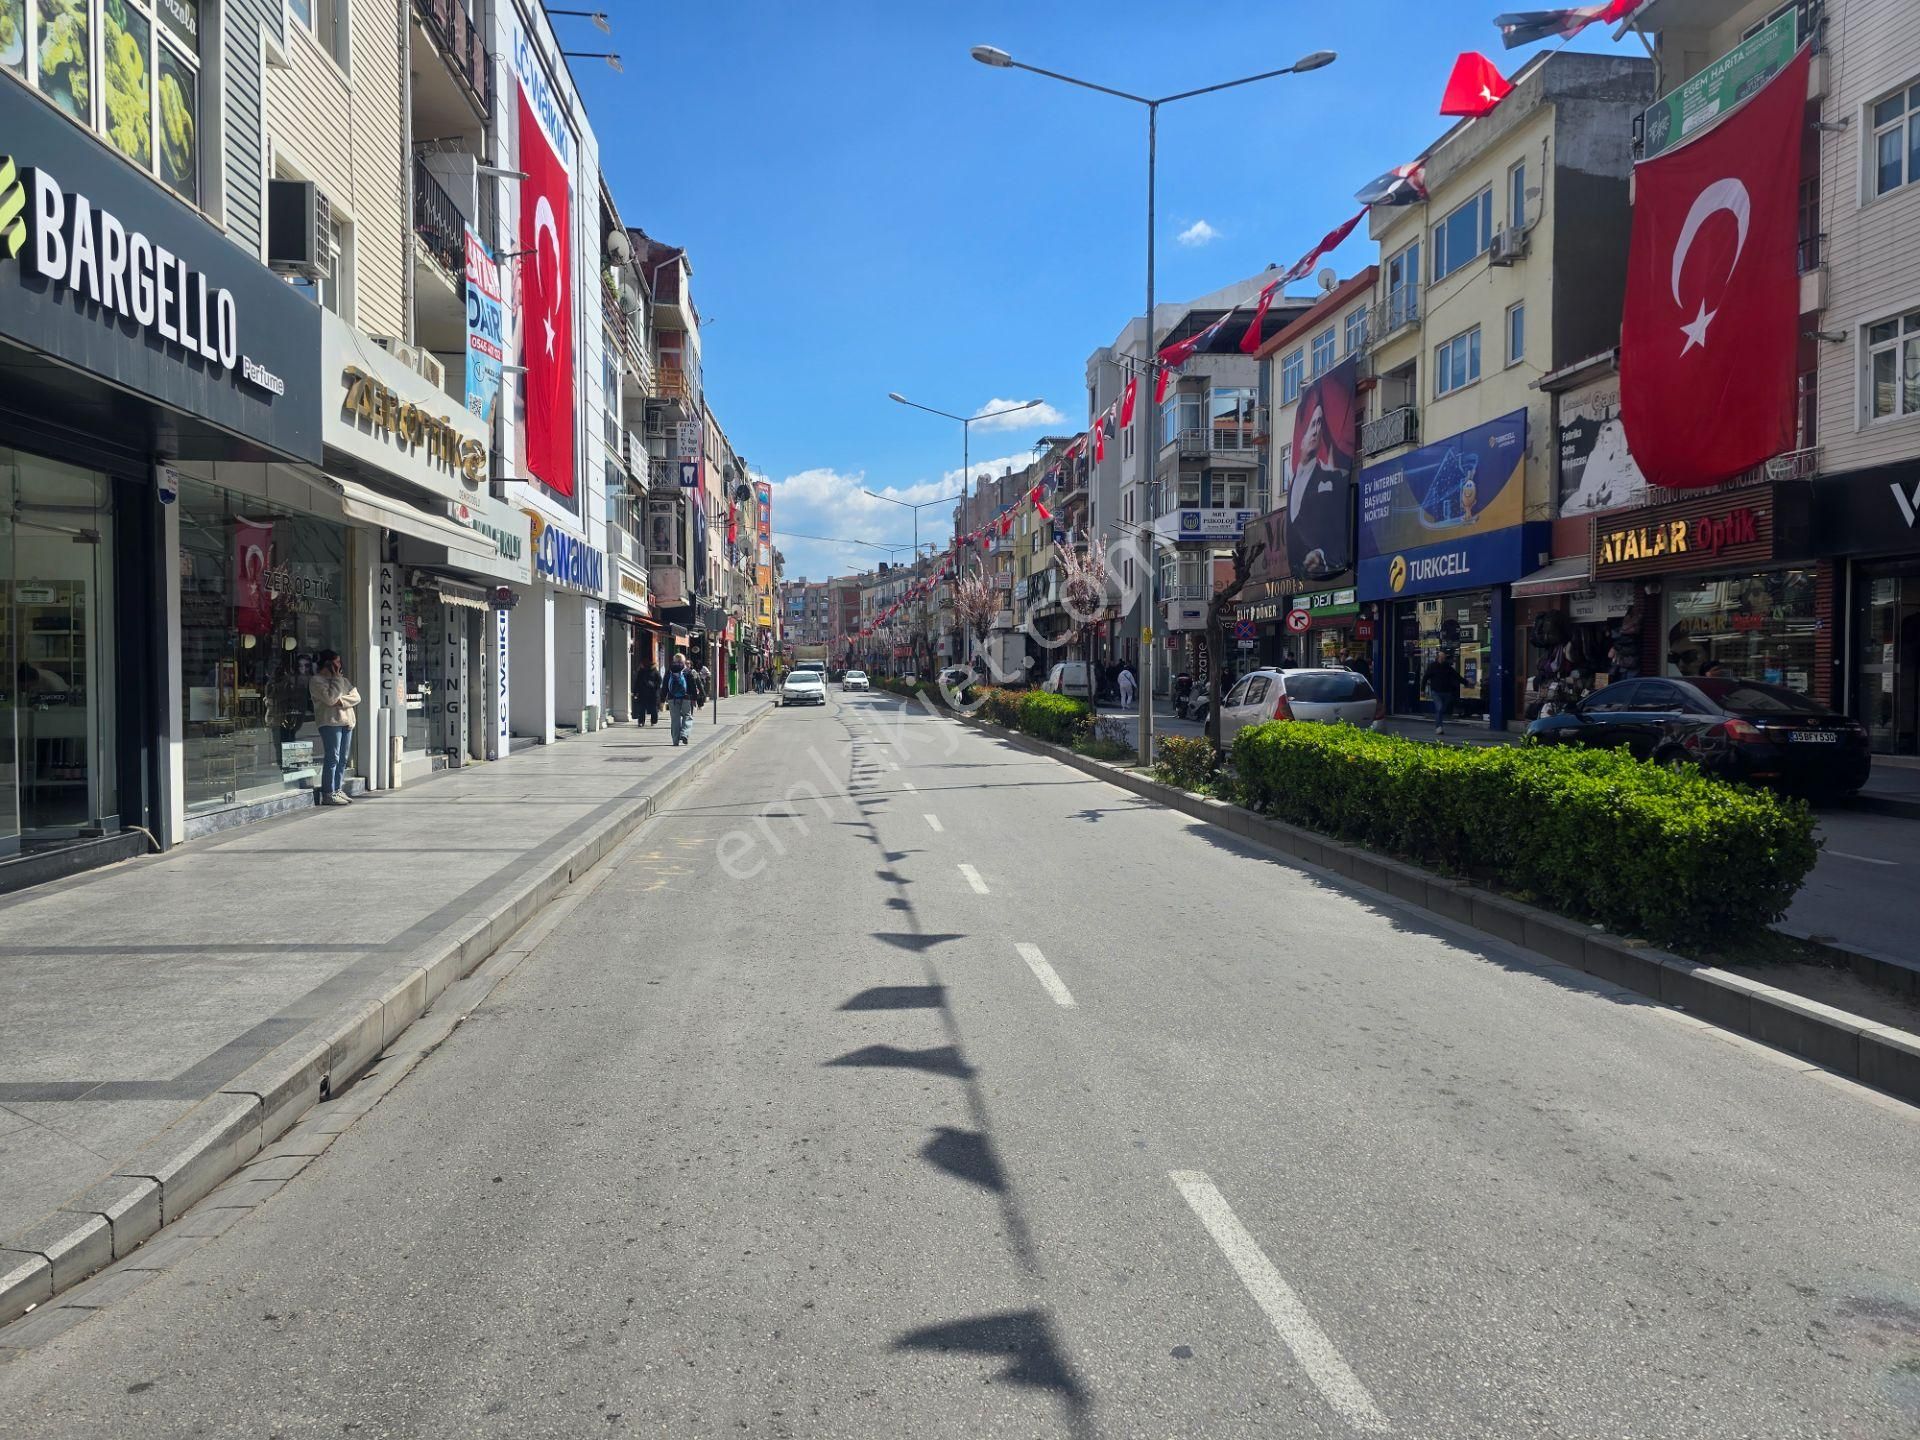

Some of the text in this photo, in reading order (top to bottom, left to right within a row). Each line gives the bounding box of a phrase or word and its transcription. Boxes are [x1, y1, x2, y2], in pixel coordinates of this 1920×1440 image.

[34, 167, 237, 370] BARGELLO
[243, 355, 284, 396] Perfume
[1364, 468, 1404, 495] EV İNTERNETİ
[1364, 492, 1391, 509] BAŞVURU
[1364, 507, 1389, 523] NOKTASI
[1598, 507, 1758, 565] ATALAR Optik
[1410, 551, 1470, 581] TURKCELL
[263, 570, 333, 600] ZER OPTİK
[1256, 604, 1277, 620] DÖNER
[380, 568, 392, 706] ANAHTARCI
[446, 606, 459, 759] İLİNGİR
